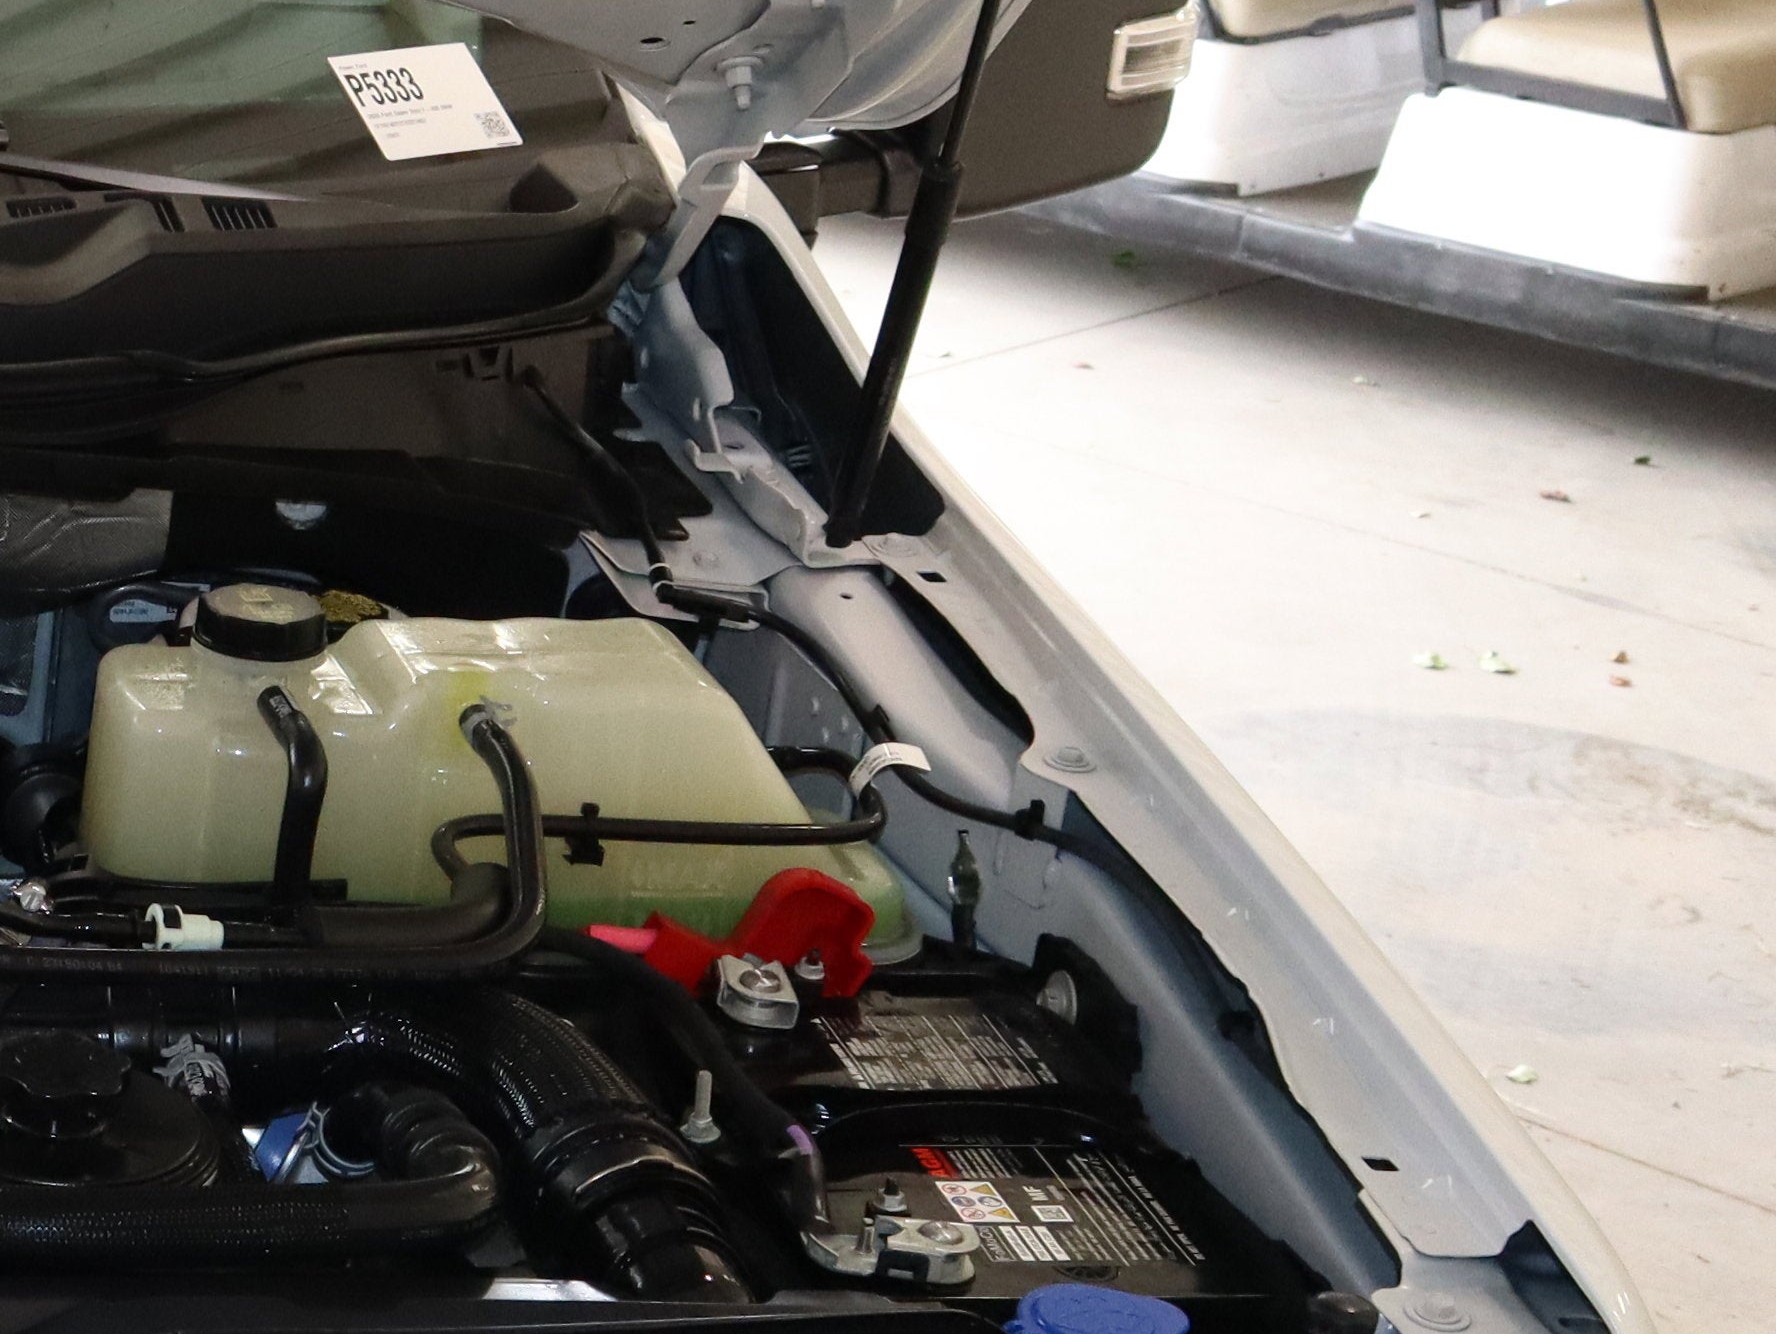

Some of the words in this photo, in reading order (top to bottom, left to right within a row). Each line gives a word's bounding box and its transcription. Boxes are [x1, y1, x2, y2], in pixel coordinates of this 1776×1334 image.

[343, 67, 424, 107] P5333
[910, 1147, 946, 1177] AGM
[1022, 1184, 1049, 1201] MF
